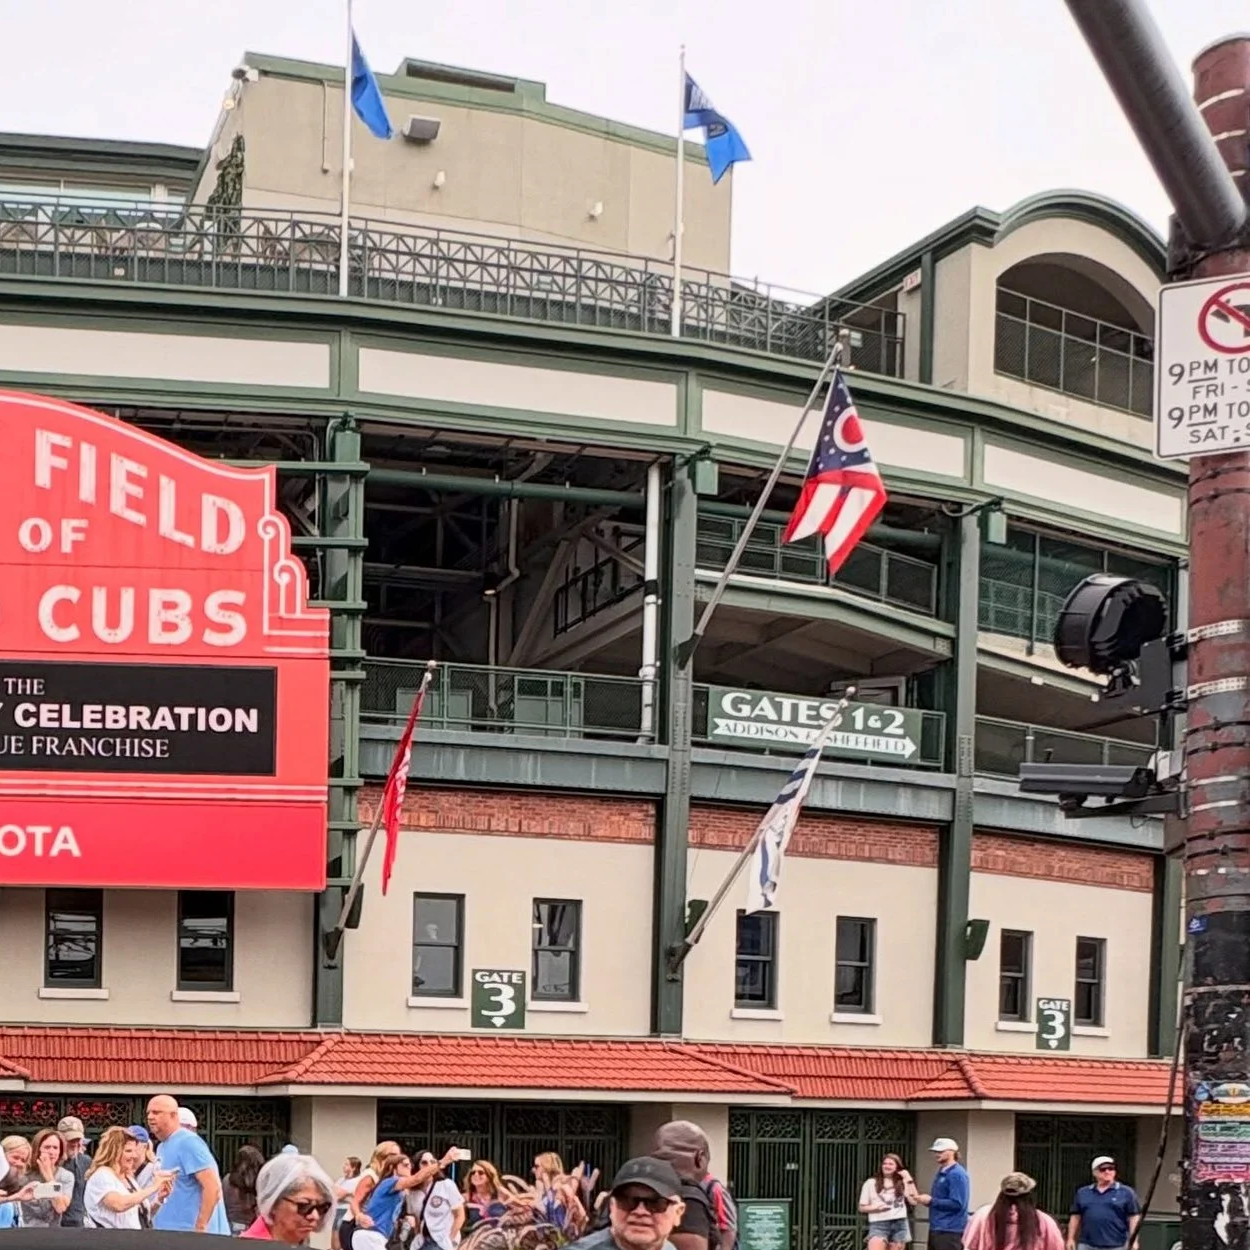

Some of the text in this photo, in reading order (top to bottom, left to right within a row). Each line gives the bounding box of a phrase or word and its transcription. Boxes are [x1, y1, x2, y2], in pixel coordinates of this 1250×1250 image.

[1227, 356, 1250, 375] TO
[1192, 383, 1224, 400] FRI
[1226, 400, 1250, 419] TO
[1189, 425, 1229, 444] SAT
[34, 427, 247, 555] FIELD
[18, 517, 89, 553] OF
[37, 585, 248, 647] CUBS
[4, 678, 45, 695] THE
[14, 703, 258, 733] CELEBRATION
[721, 692, 905, 735] GATES 1&2
[31, 737, 170, 758] FRANCHISE
[720, 721, 798, 743] ADDISON
[825, 734, 906, 752] SHEFFIELD
[475, 971, 523, 984] GATE
[481, 983, 516, 1016] 3
[1038, 999, 1069, 1011] GATE
[1041, 1010, 1066, 1039] 3
